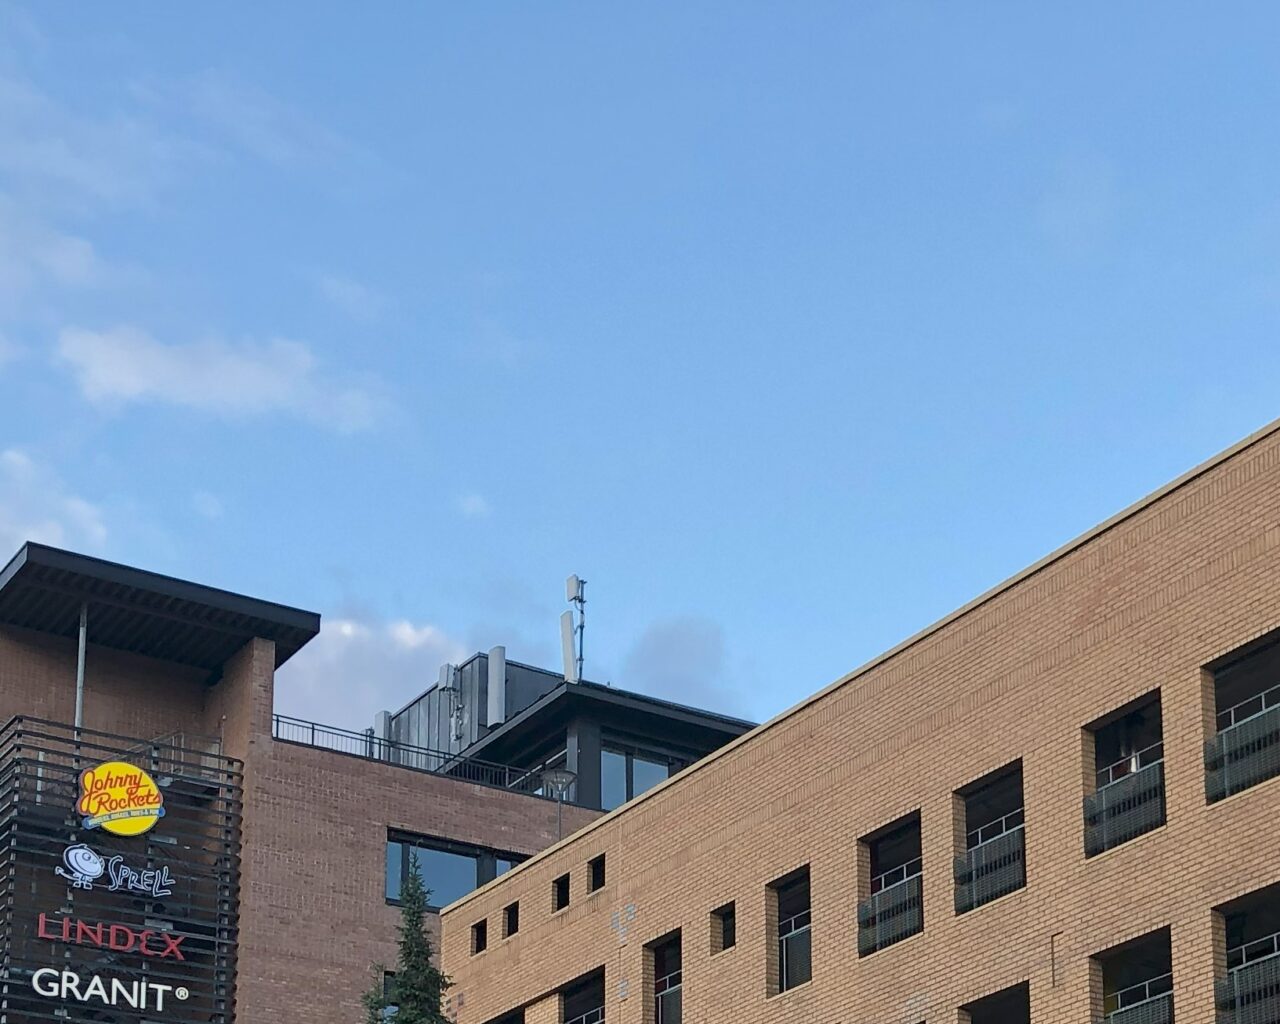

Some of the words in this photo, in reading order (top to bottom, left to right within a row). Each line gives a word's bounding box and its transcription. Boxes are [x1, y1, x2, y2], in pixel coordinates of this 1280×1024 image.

[80, 770, 149, 811] Johnny
[89, 787, 161, 814] Rockets
[108, 855, 176, 897] SPRELL
[38, 912, 185, 961] LINDEX
